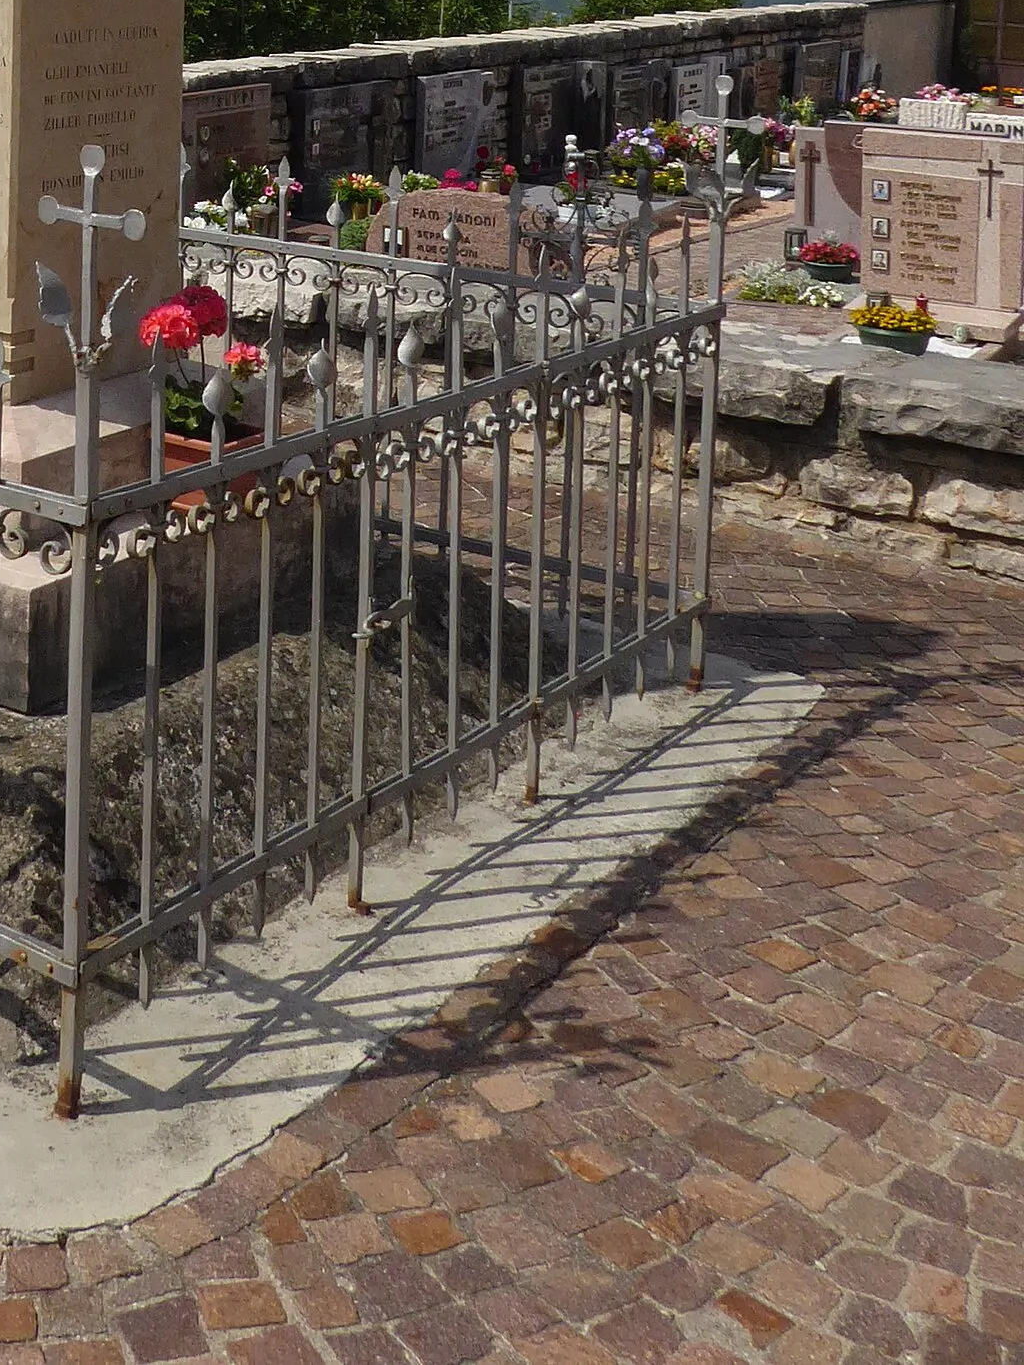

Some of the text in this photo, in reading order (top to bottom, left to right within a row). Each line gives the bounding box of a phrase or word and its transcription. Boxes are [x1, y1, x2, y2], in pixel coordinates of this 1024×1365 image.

[55, 25, 158, 44] CADUTI IN GUERRA
[44, 114, 81, 131] ZILLER
[110, 166, 144, 182] EMILIO
